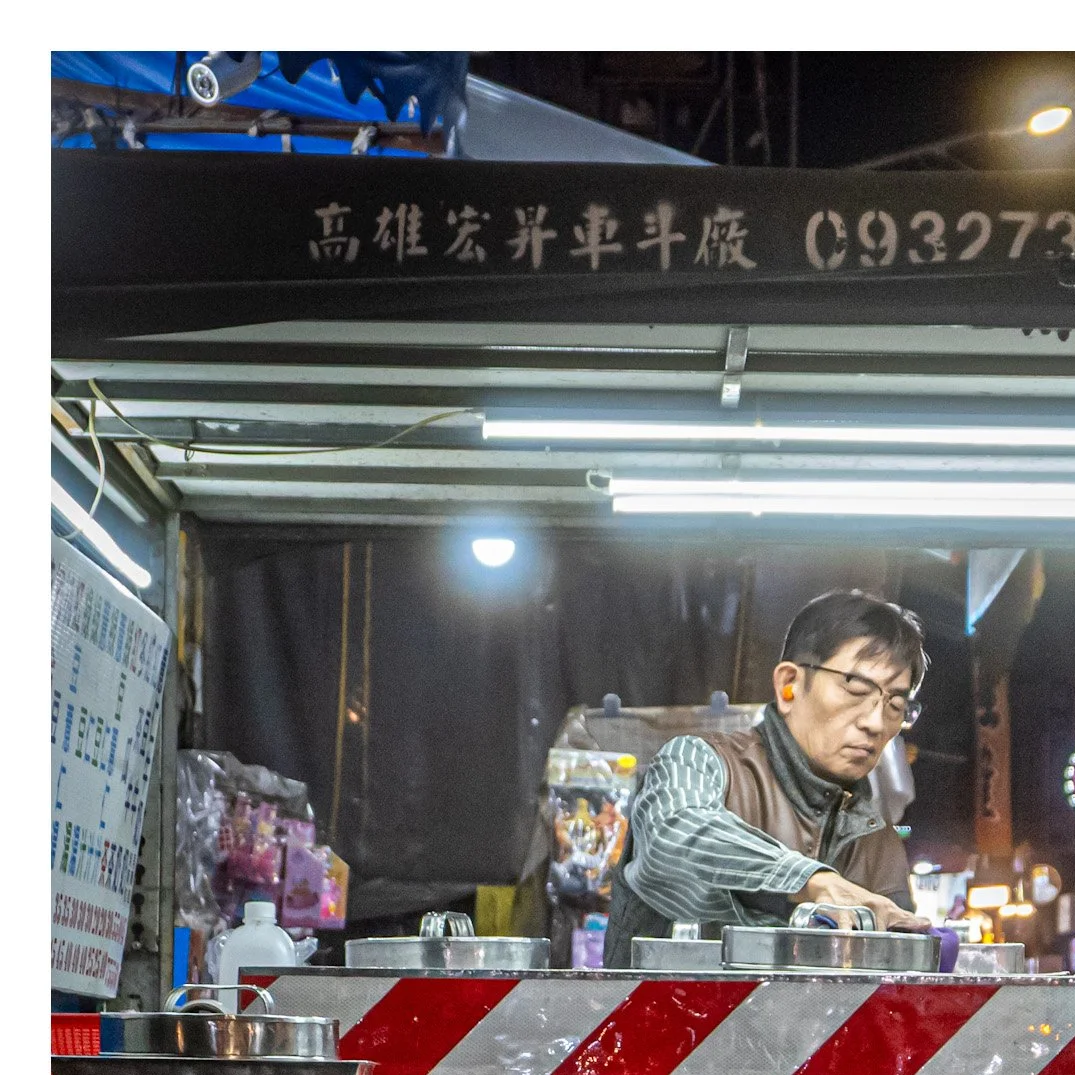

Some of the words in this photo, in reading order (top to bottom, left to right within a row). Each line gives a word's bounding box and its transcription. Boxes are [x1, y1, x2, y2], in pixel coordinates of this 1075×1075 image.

[308, 203, 758, 271] 高雄宏昇車斗廠
